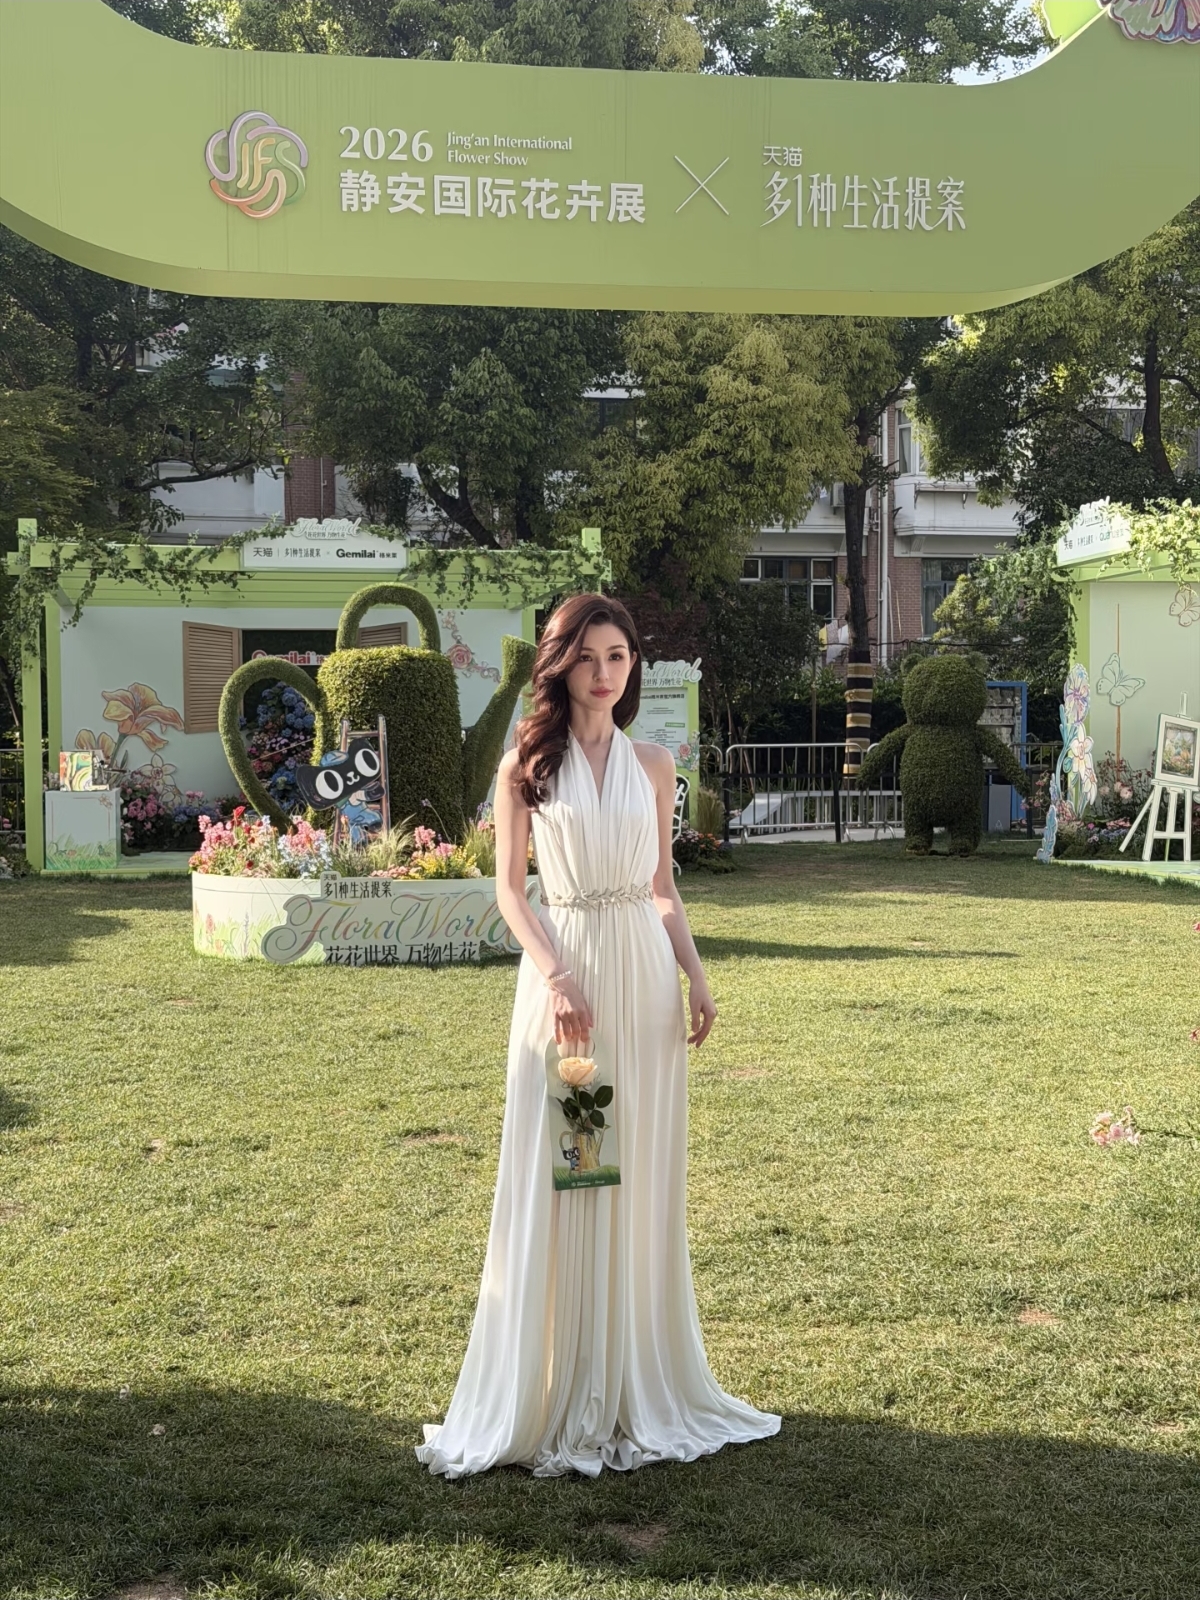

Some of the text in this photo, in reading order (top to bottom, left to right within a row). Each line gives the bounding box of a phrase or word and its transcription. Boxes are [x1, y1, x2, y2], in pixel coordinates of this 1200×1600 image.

[339, 126, 434, 163] 2026
[493, 134, 573, 151] International
[446, 151, 529, 167] Flower Show
[763, 145, 803, 167] 天猫
[339, 169, 647, 224] 静安国际花卉展
[253, 547, 273, 558] 天猫
[336, 548, 376, 559] Gemilai
[262, 895, 421, 961] Floral
[326, 942, 478, 965] 花花世界 万物生花
